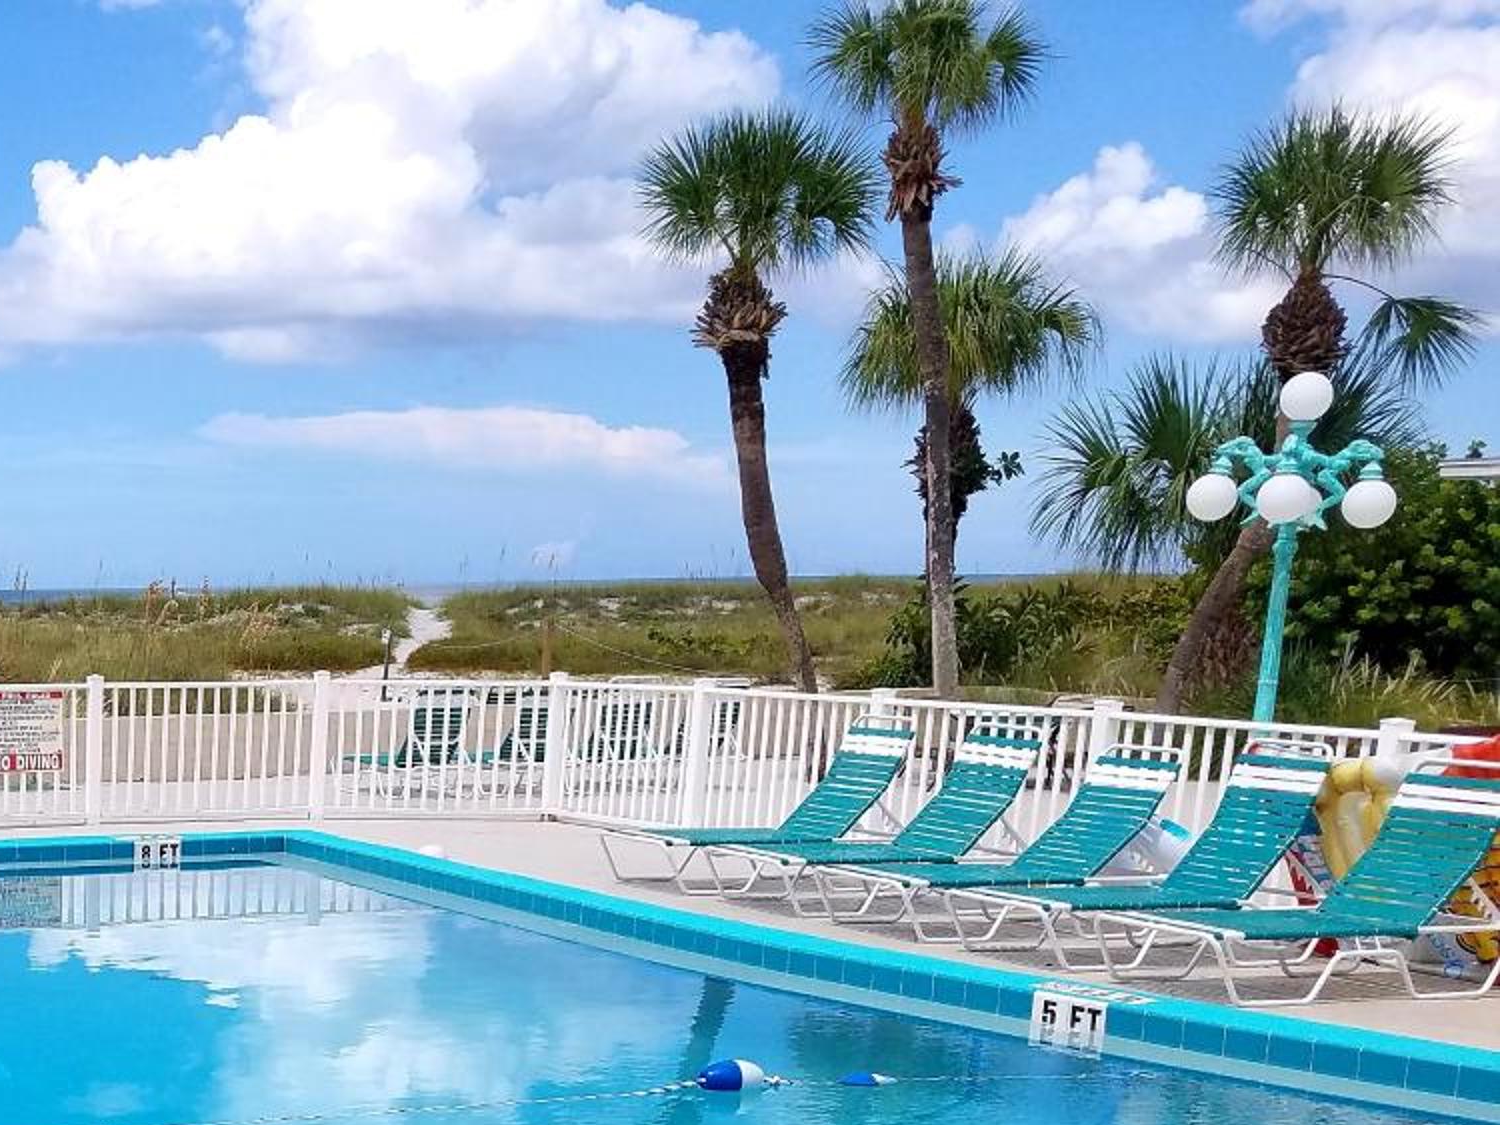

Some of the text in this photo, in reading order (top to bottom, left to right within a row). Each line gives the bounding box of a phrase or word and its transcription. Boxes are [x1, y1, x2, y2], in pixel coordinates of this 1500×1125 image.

[15, 754, 60, 770] DIVING
[141, 843, 179, 860] 8 FT
[1041, 999, 1102, 1031] 5 FT
